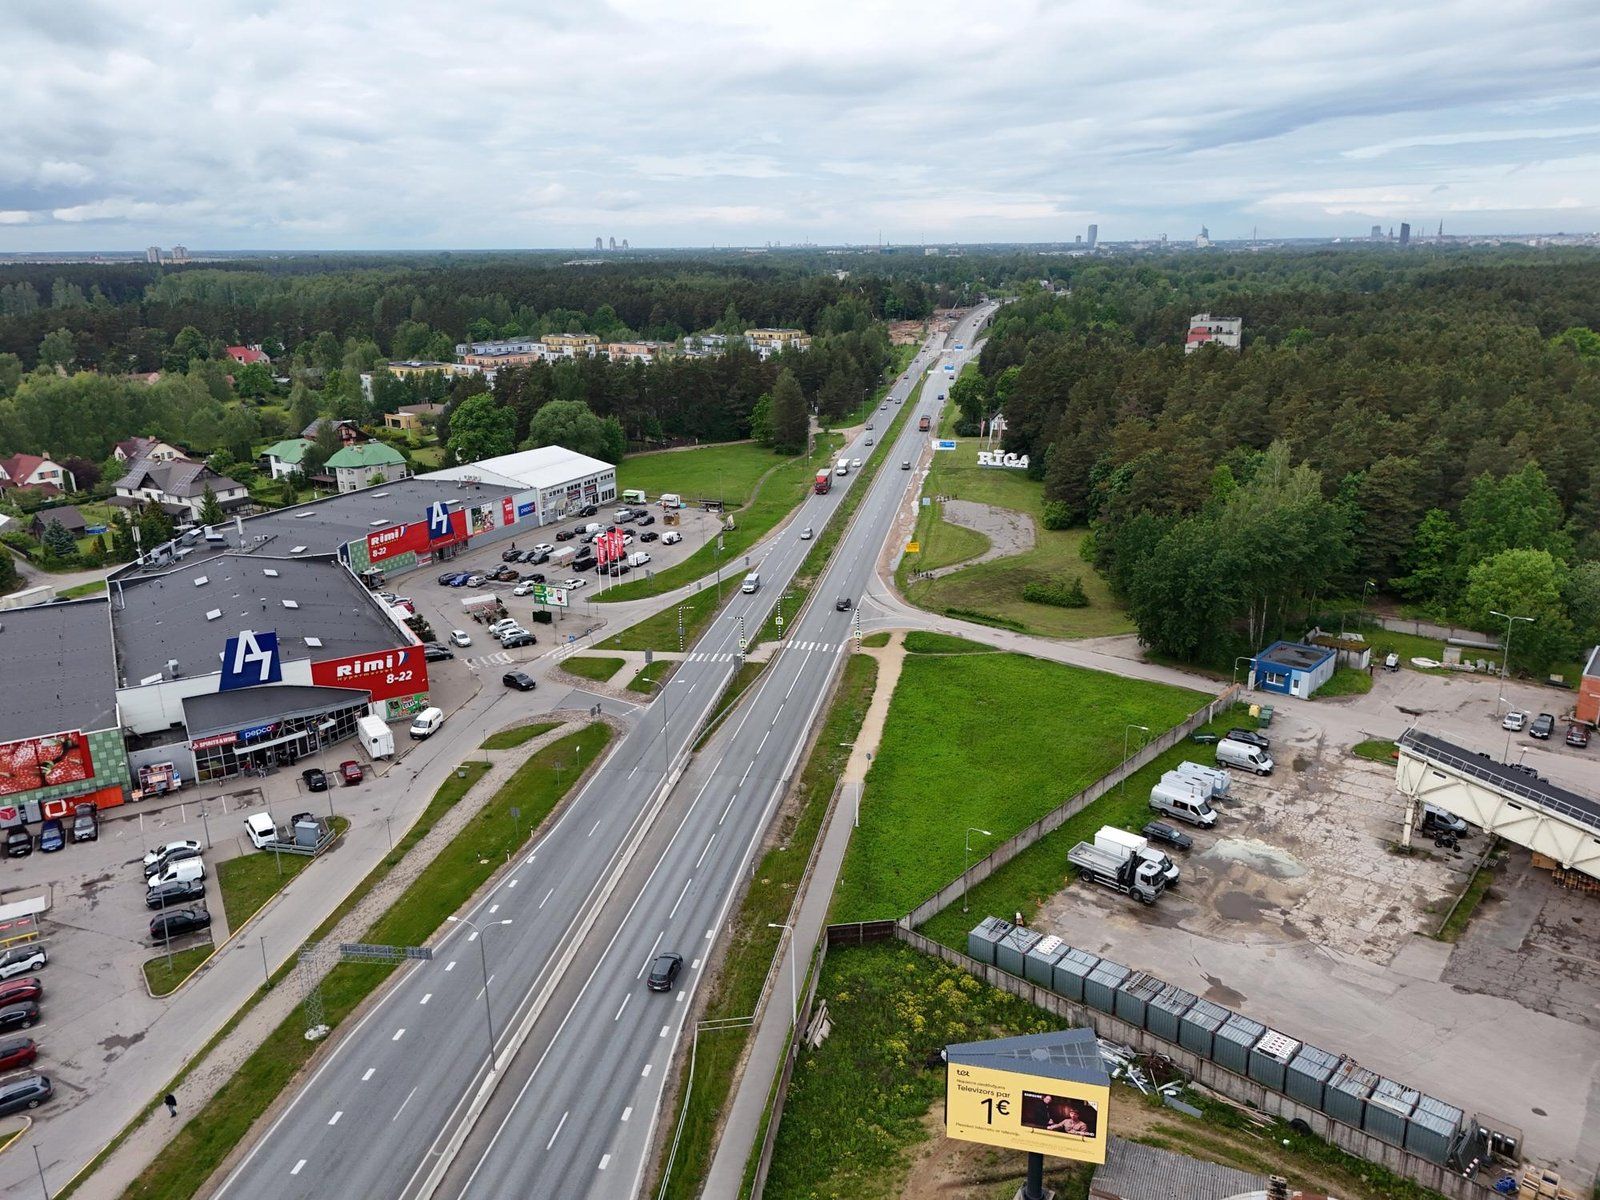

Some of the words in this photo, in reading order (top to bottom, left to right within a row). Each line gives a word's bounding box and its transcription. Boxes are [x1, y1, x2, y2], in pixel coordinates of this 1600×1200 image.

[977, 449, 1030, 468] RĪGA
[386, 670, 413, 684] 8-22
[245, 725, 272, 739] pepco
[957, 1084, 995, 1096] Televizors
[980, 1097, 1011, 1125] 1€
